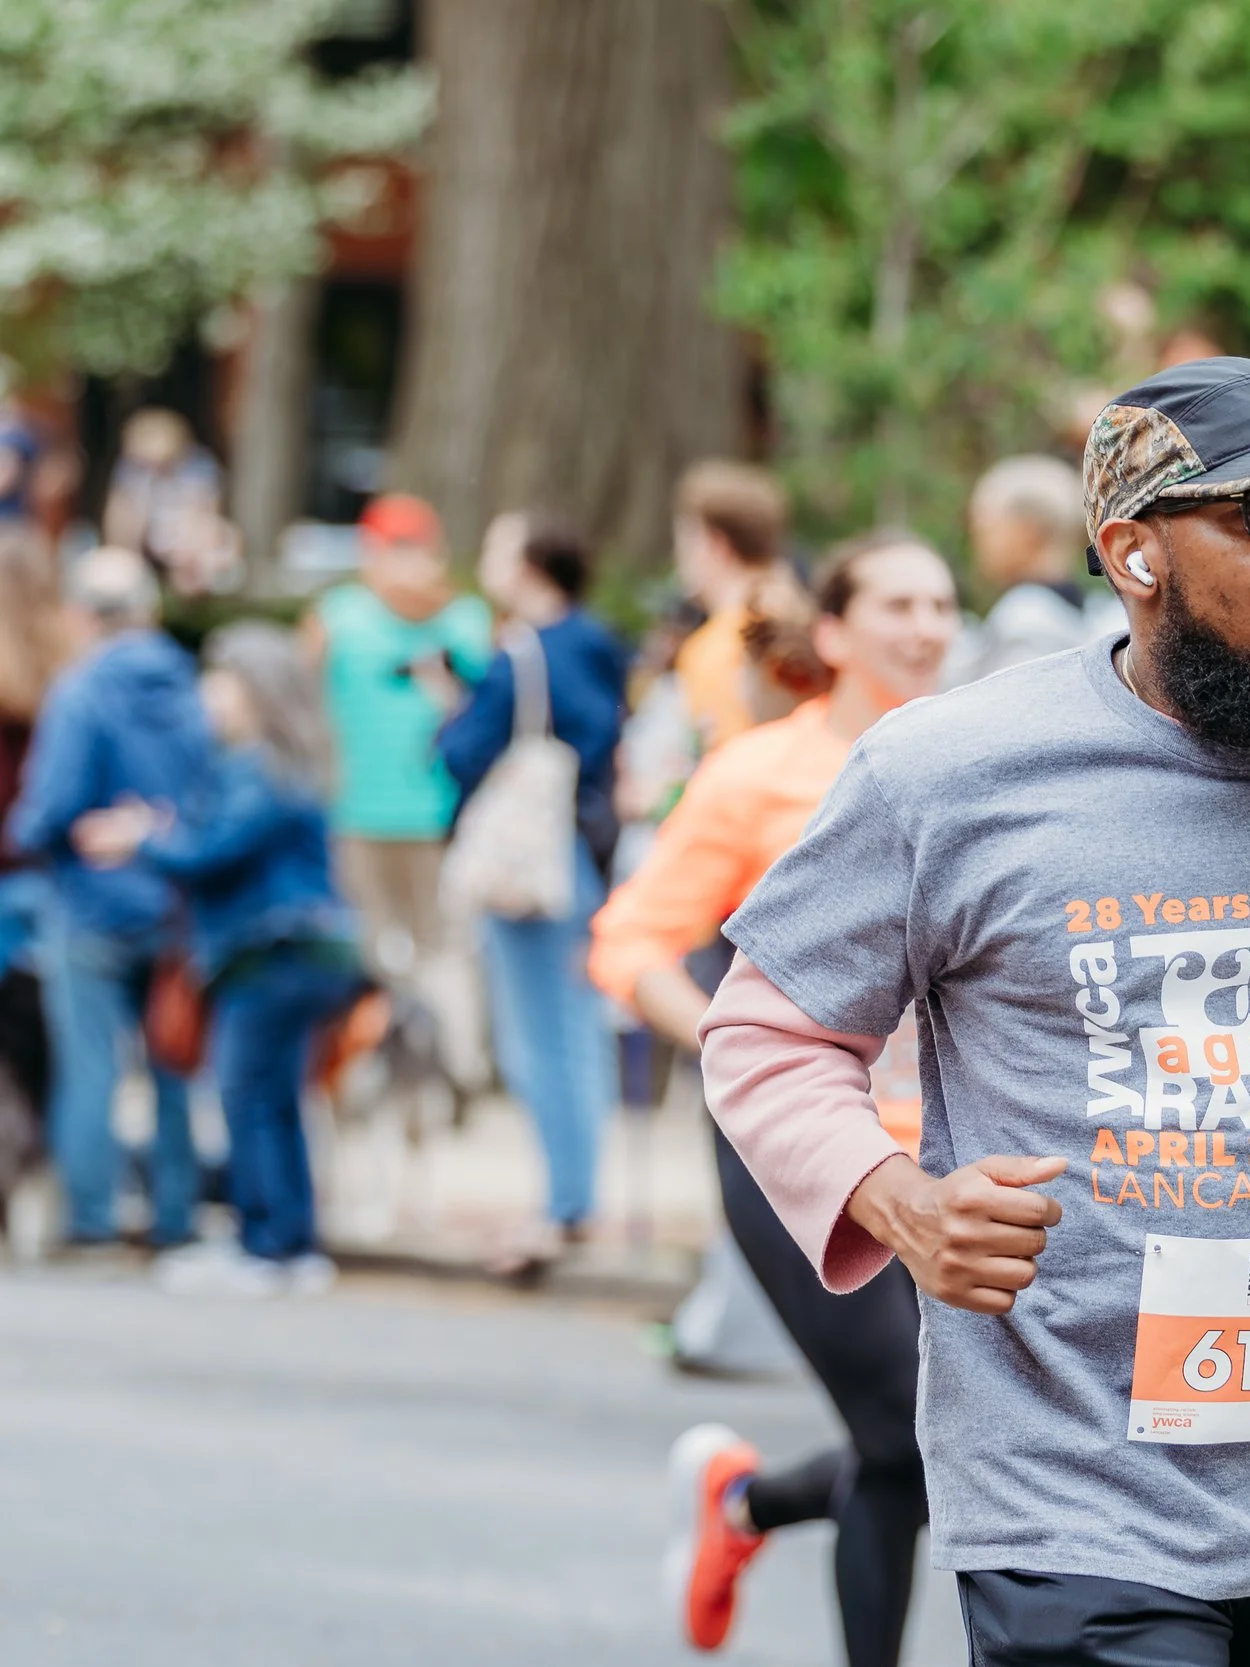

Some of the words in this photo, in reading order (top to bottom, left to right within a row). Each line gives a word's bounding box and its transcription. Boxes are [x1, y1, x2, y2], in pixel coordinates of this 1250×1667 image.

[1065, 896, 1122, 933] 28
[1132, 892, 1250, 925] Years
[1070, 941, 1144, 1118] ywca
[1090, 1129, 1237, 1168] APRIL
[1152, 1417, 1192, 1429] ywca
